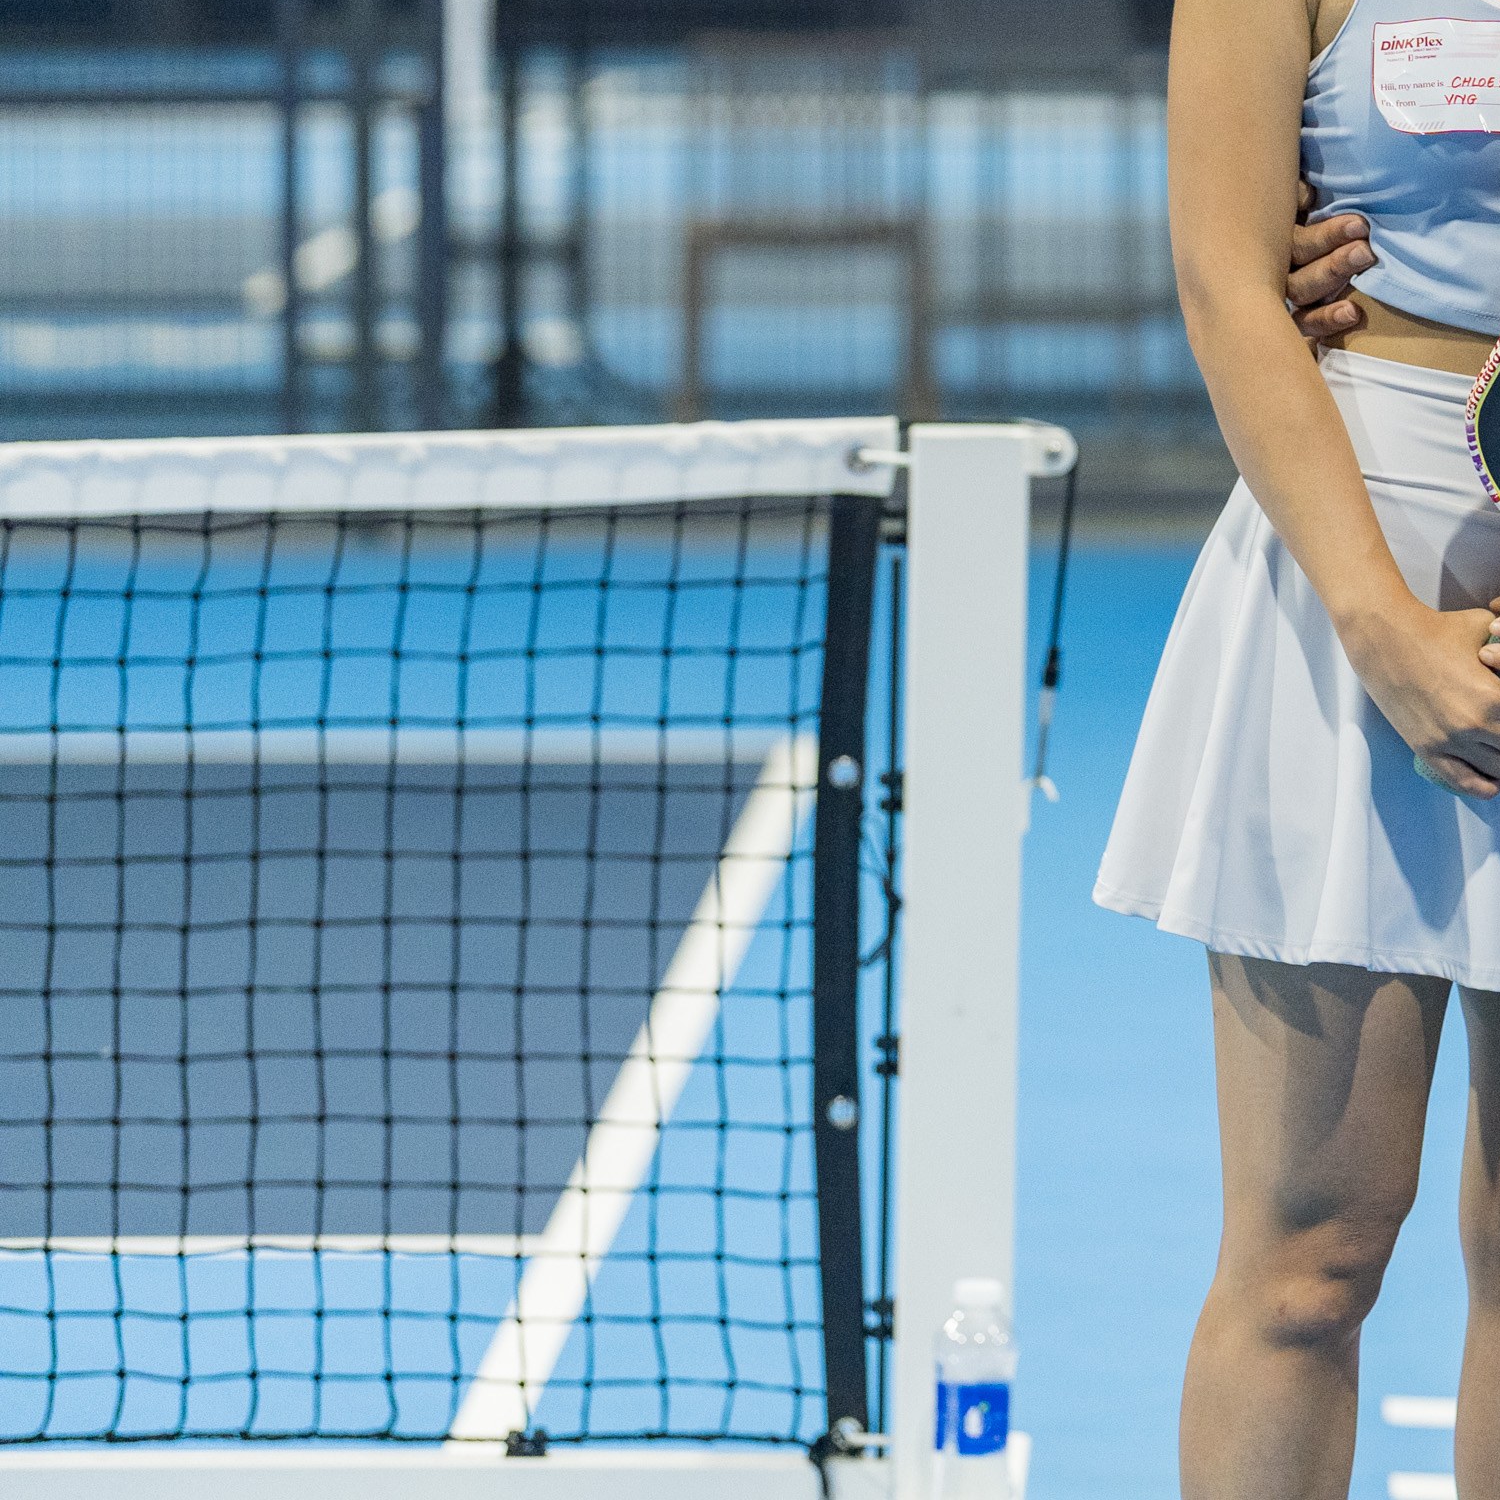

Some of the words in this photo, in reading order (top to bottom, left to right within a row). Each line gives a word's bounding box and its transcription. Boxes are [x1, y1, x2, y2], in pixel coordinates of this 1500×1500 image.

[1416, 36, 1443, 48] Plex
[1398, 83, 1411, 91] my
[1451, 76, 1495, 89] CHLOE
[1396, 99, 1416, 107] from
